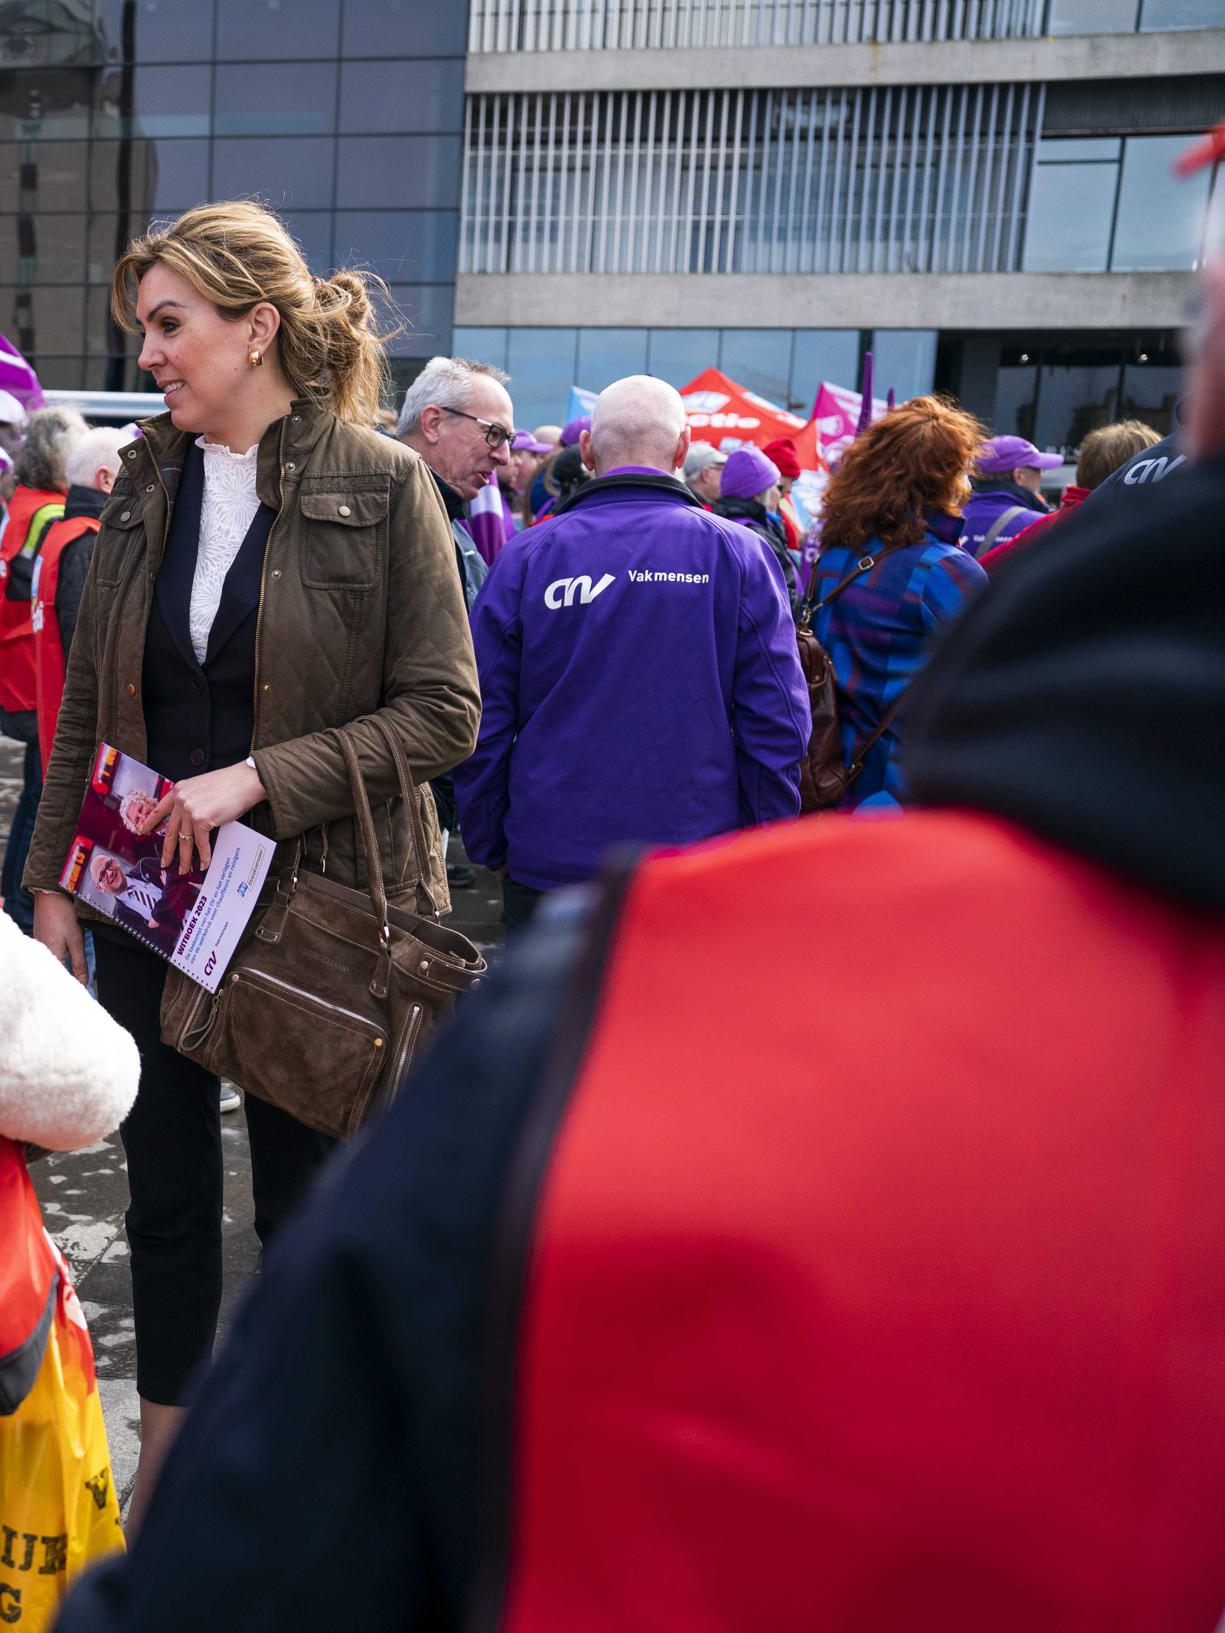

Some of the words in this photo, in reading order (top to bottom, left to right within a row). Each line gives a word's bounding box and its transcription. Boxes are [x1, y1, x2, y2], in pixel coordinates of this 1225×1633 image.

[1123, 454, 1187, 485] CNV
[544, 573, 616, 610] CNV
[628, 570, 709, 584] Vakmensen
[176, 915, 198, 955] WITBOEK
[194, 894, 207, 915] 2023
[204, 950, 217, 976] CNV
